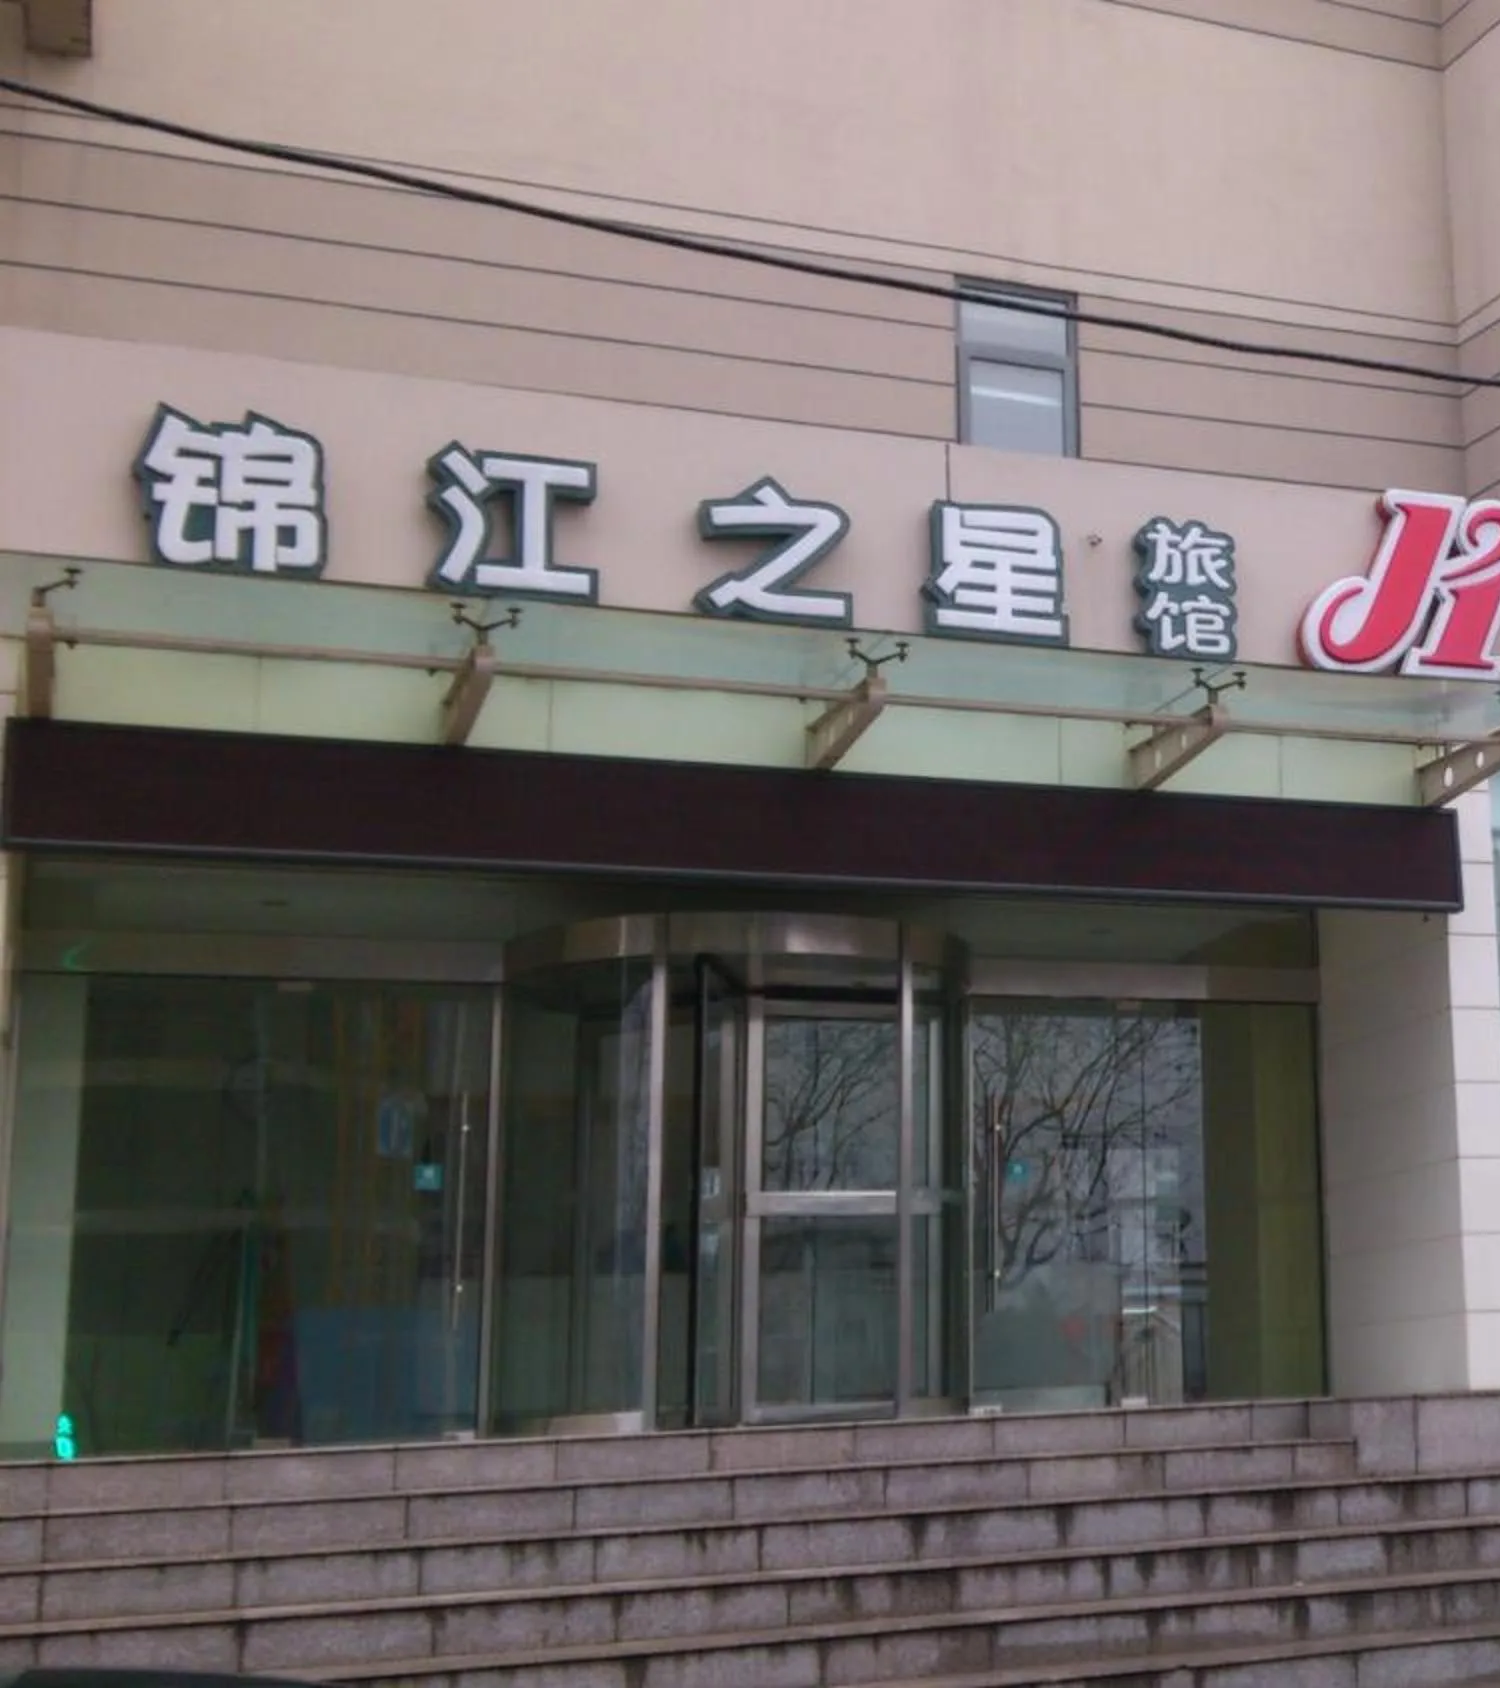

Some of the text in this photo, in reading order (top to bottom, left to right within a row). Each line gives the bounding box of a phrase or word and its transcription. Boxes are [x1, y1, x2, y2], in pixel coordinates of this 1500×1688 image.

[142, 412, 1065, 640] 锦江之星
[1143, 520, 1235, 656] 旅馆
